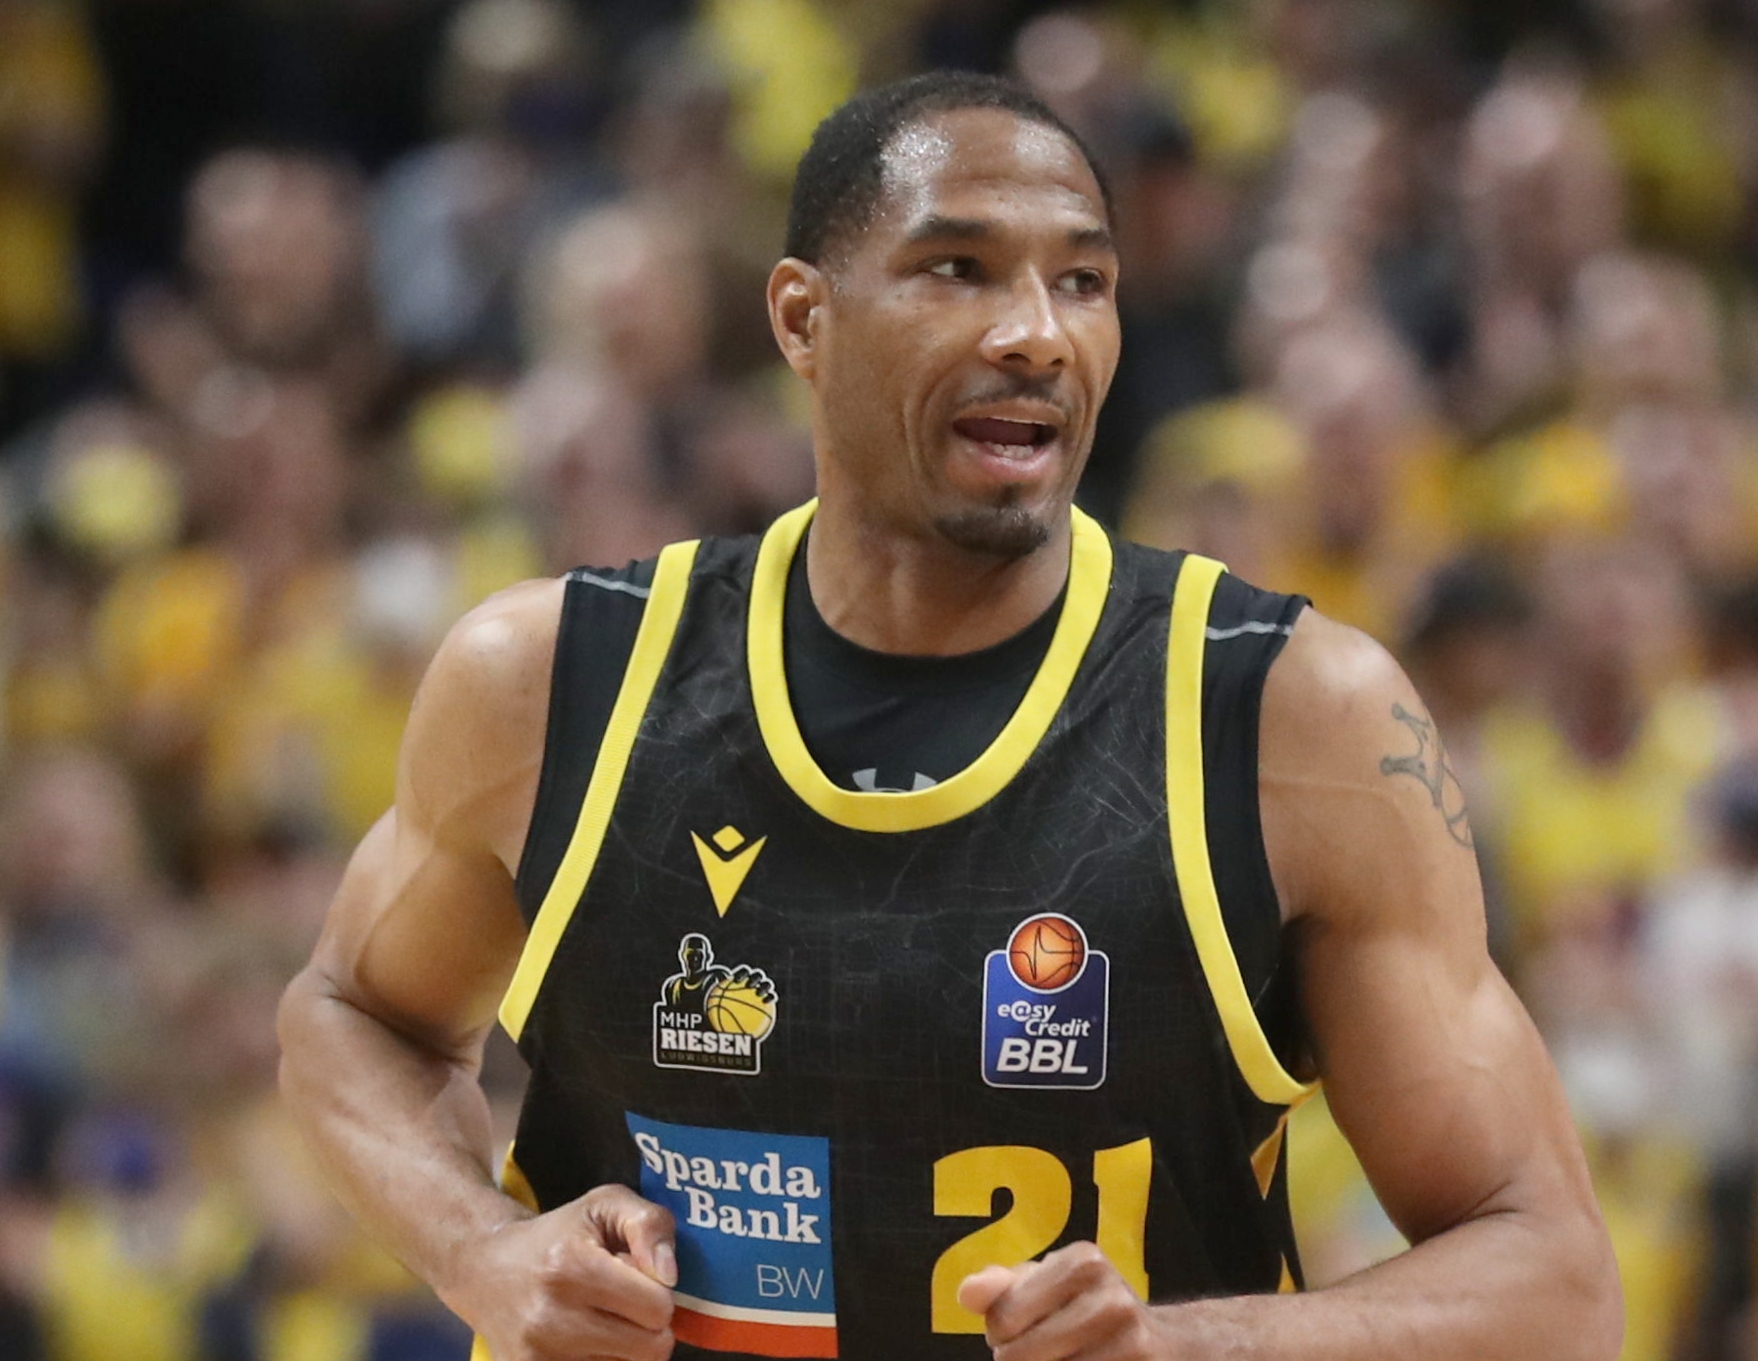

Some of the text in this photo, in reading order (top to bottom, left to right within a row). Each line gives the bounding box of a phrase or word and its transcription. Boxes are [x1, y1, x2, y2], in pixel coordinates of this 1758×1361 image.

[661, 1011, 702, 1029] MHP
[997, 1000, 1057, 1023] e@sy
[1025, 1018, 1091, 1037] Credit
[661, 1028, 751, 1056] RIESEN
[996, 1038, 1088, 1074] BBL
[634, 1132, 822, 1199] Sparda
[684, 1186, 822, 1244] Bank
[931, 1137, 1152, 1334] 21
[757, 1264, 824, 1300] BW
